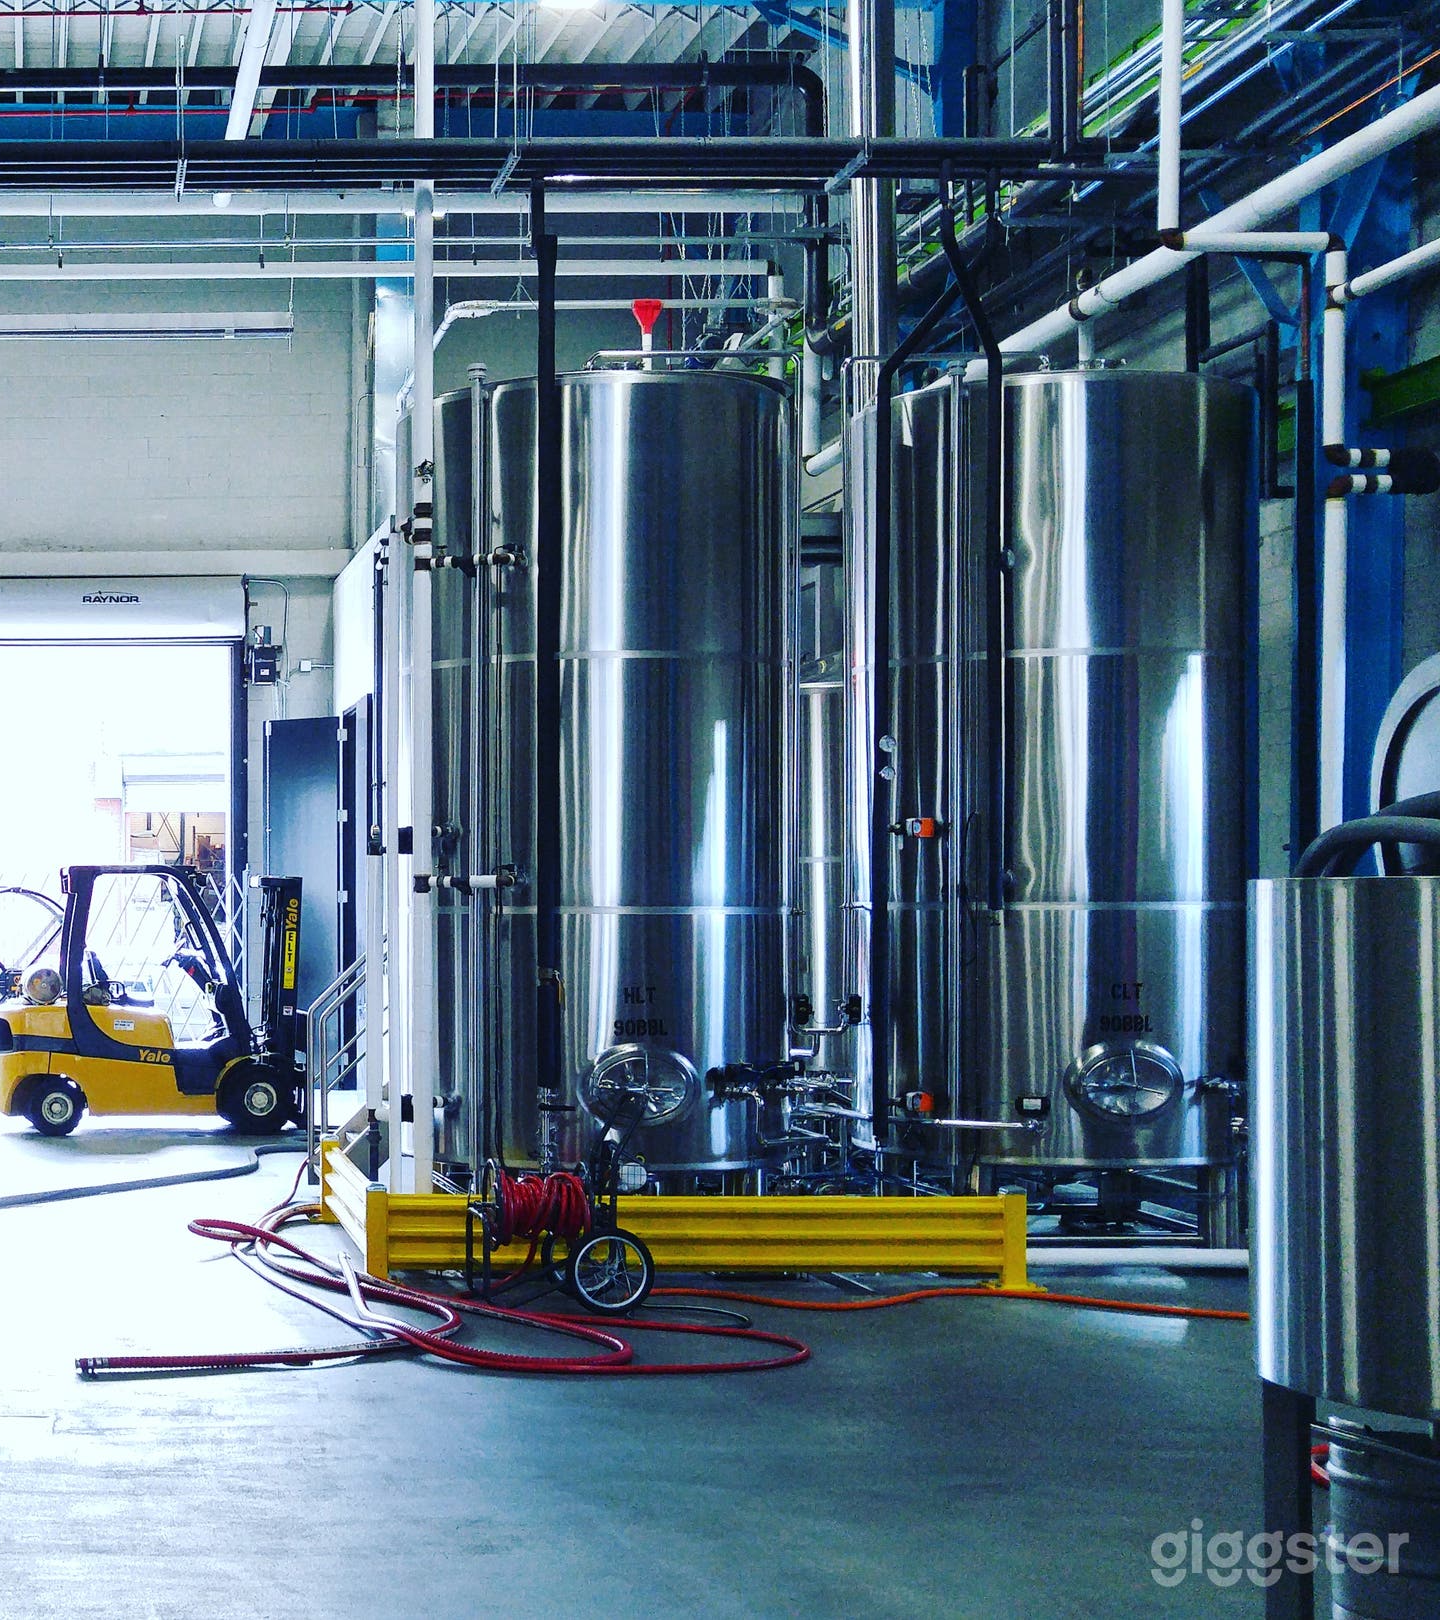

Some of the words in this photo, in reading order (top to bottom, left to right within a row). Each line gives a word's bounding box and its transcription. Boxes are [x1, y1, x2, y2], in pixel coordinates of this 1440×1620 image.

[82, 595, 140, 604] RAYNOR
[285, 898, 299, 930] Yale
[624, 987, 656, 1004] HLT
[1111, 983, 1144, 999] CLT
[139, 1049, 171, 1063] Yale
